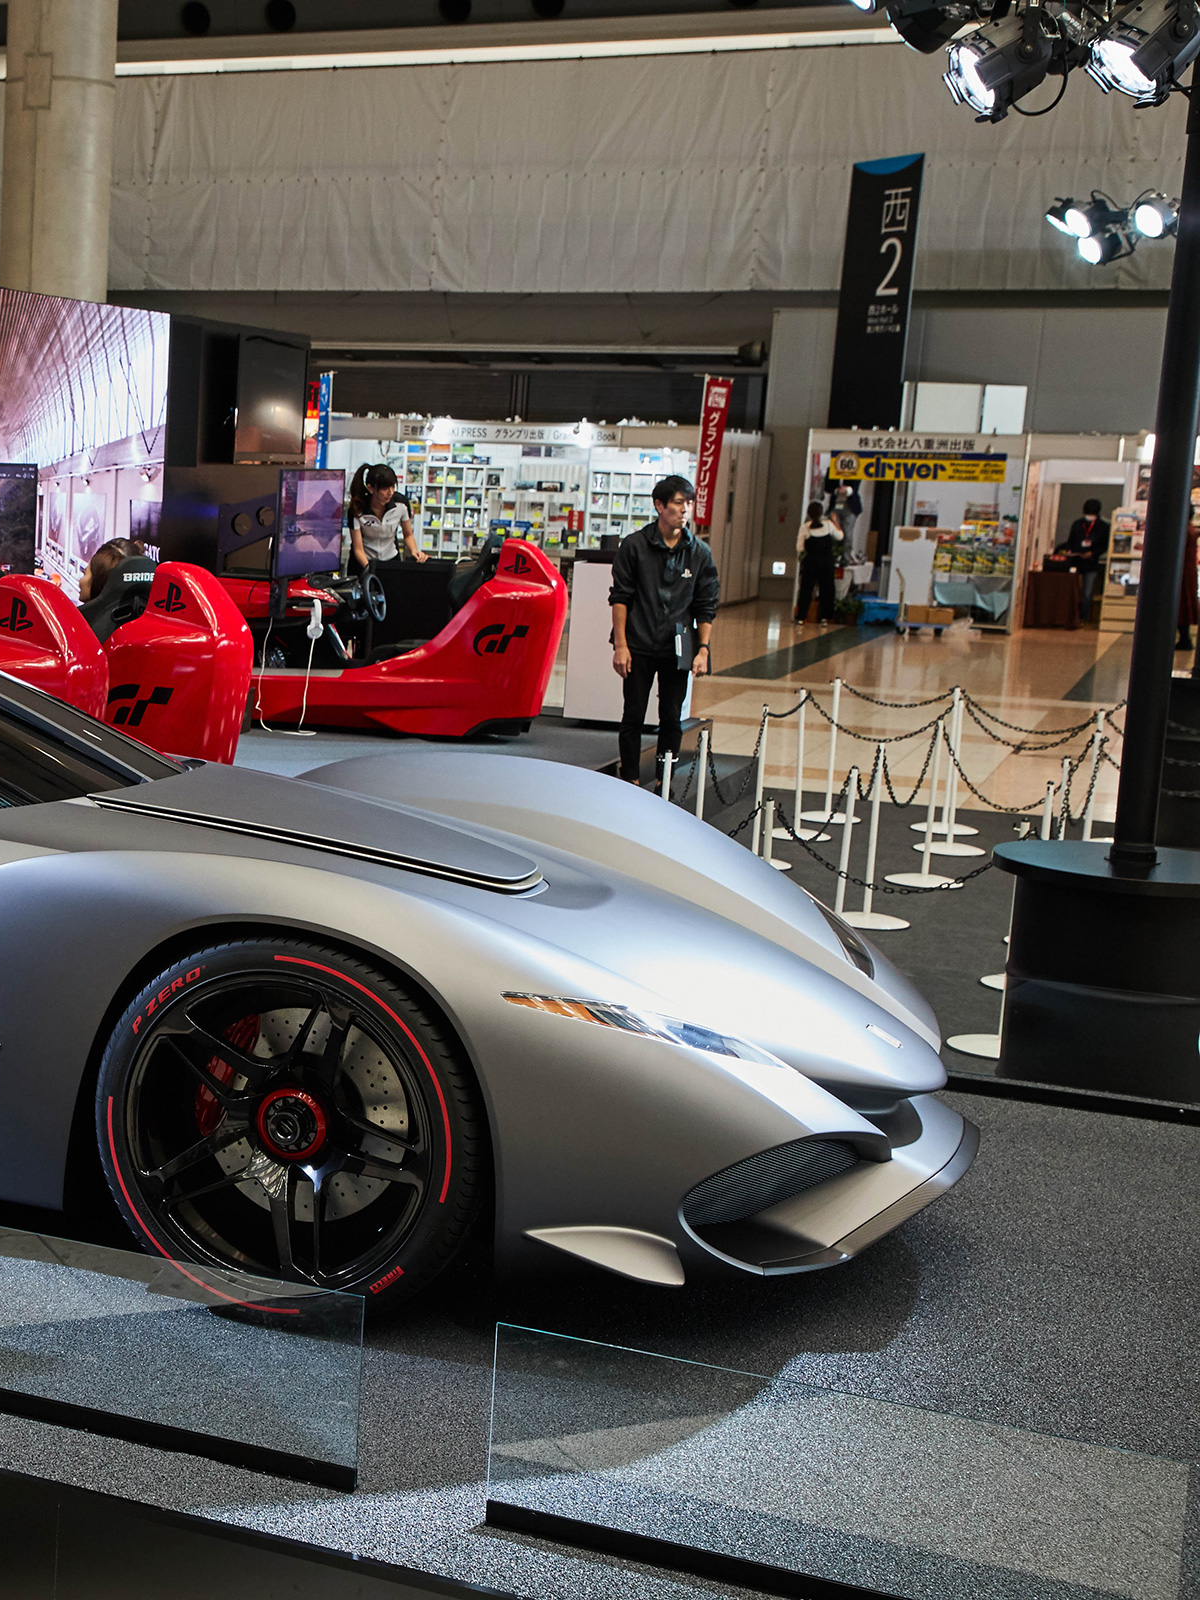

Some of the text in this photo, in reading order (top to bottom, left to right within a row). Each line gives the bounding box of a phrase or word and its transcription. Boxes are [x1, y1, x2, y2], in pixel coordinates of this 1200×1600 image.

[461, 428, 487, 438] PRESS
[494, 428, 544, 440] グランプリ出版
[597, 432, 617, 441] Book
[858, 437, 975, 450] 株式会社八重洲出版
[863, 454, 947, 480] driver
[123, 572, 155, 582] BRIDE
[132, 967, 201, 1034] P ZERO
